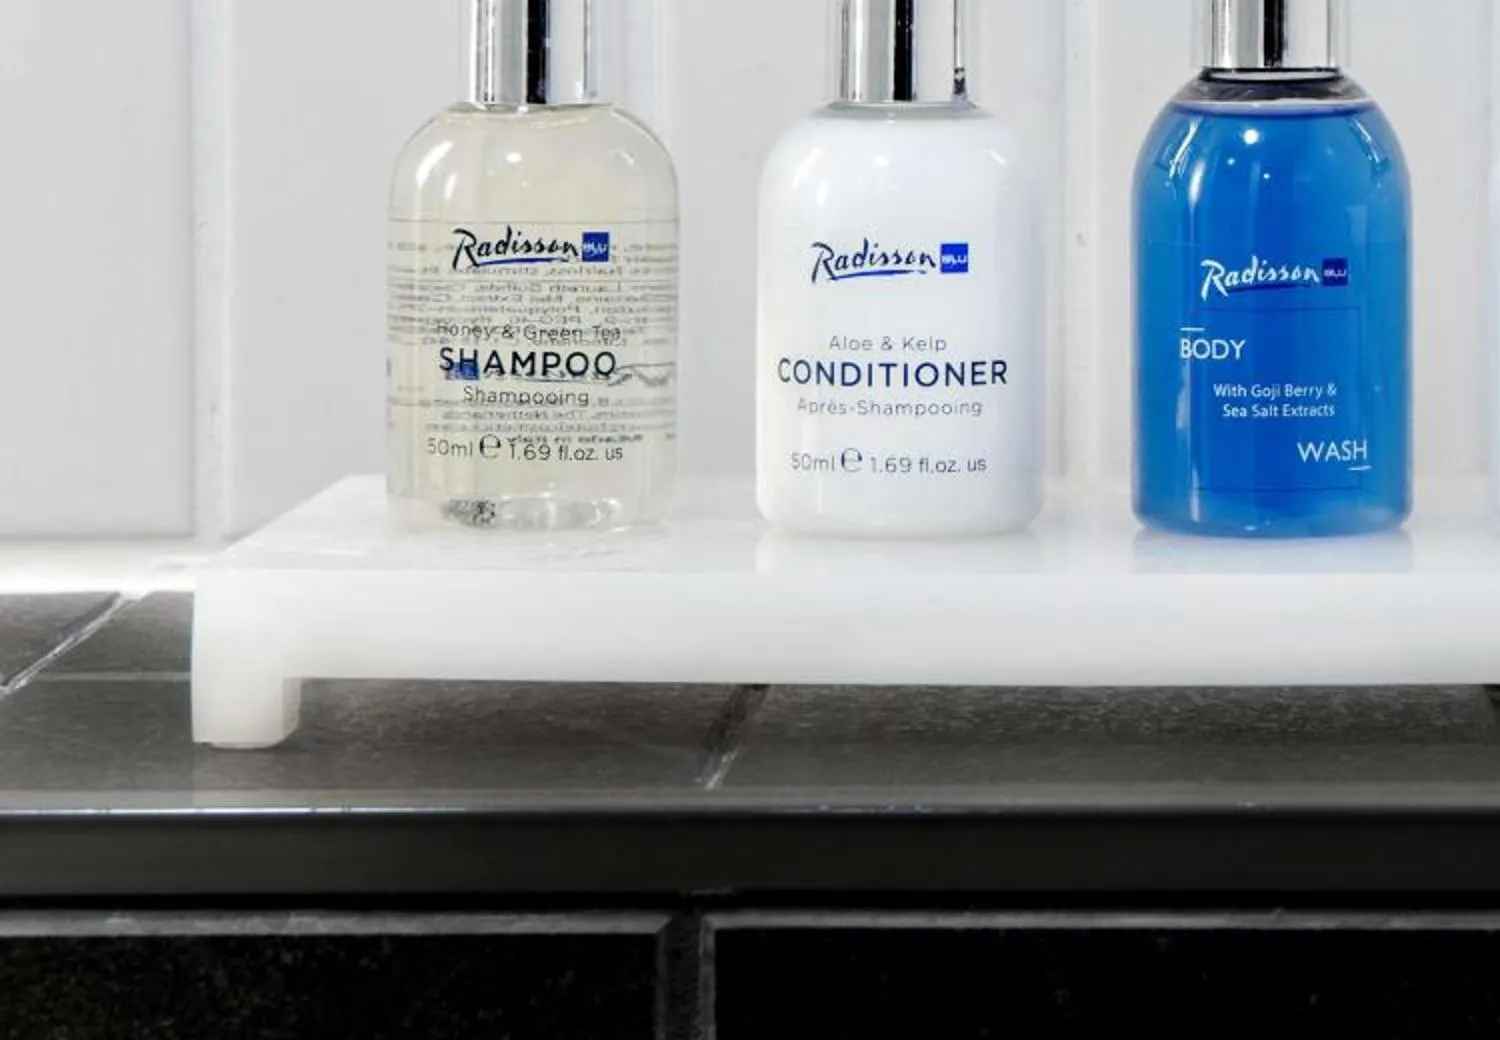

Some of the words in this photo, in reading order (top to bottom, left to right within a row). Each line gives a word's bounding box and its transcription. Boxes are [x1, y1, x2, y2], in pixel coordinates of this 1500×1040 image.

[452, 225, 578, 270] Radisson
[811, 238, 936, 283] Radisson
[1200, 255, 1320, 301] Radisson
[523, 324, 583, 340] Green
[592, 324, 621, 339] Tea
[829, 335, 872, 351] Aloe
[880, 335, 893, 351] &
[902, 335, 947, 354] Kelp
[1180, 338, 1246, 360] BODY
[440, 347, 617, 377] SHAMPOO
[777, 357, 1007, 388] CONDITIONER
[463, 386, 589, 406] Shampooing
[1213, 384, 1246, 398] With
[1250, 383, 1281, 401] Goji
[1285, 384, 1323, 400] Berry
[1327, 383, 1337, 397] &
[1222, 404, 1247, 418] Sea
[1251, 404, 1278, 418] Salt
[1282, 404, 1335, 417] Extracts
[427, 438, 474, 456] 50ml
[508, 443, 551, 461] 1.69
[605, 446, 623, 460] us
[1297, 440, 1367, 462] WASH
[790, 453, 835, 473] 50ml
[870, 457, 912, 473] 1.69
[967, 458, 987, 472] us
